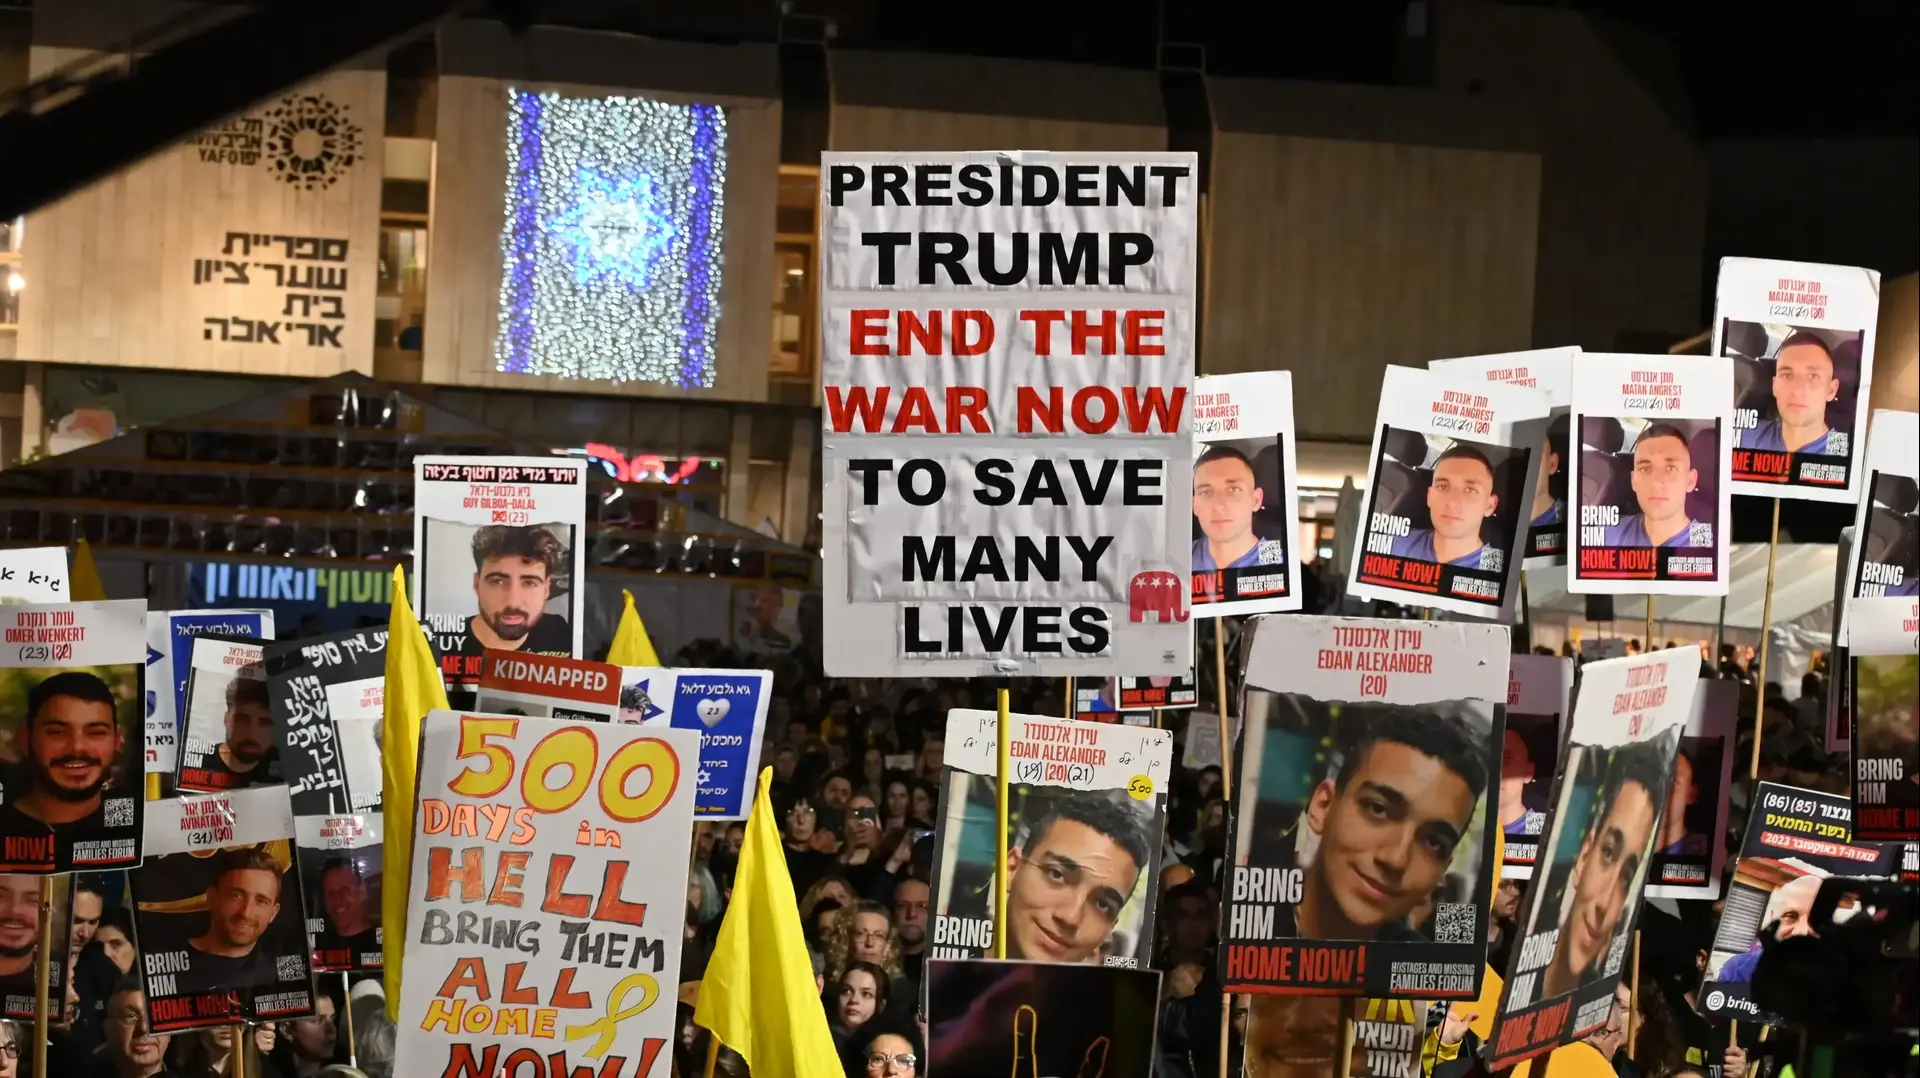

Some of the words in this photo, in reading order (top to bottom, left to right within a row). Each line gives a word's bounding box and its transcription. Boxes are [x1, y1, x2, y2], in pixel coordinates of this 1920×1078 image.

[829, 164, 1190, 207] PRESIDENT
[222, 231, 349, 262] ספריית
[861, 232, 1154, 286] TRUMP
[283, 293, 345, 319] בית
[1768, 291, 1794, 303] MATAN
[1796, 293, 1828, 307] ANGREST
[203, 316, 344, 348] אריאלה
[849, 309, 995, 356] END
[1020, 310, 1166, 356] THE
[1622, 384, 1647, 395] MATAN
[1649, 384, 1682, 397] ANGREST
[825, 386, 992, 433] WAR
[1017, 385, 1187, 434] NOW
[1206, 405, 1239, 418] ANGREST
[1432, 402, 1458, 416] MATAN
[1460, 407, 1495, 421] ANGREST
[424, 465, 460, 480] בעזה
[463, 465, 495, 482] חטוף
[523, 467, 546, 482] מדי
[1753, 453, 1790, 475] NOW!
[498, 467, 519, 484] זמן
[549, 467, 576, 483] יותר
[849, 458, 946, 506] TO
[973, 458, 1163, 506] SAVE
[1800, 468, 1825, 480] FAMILIES
[1826, 470, 1845, 482] FORUM
[463, 497, 479, 509] GUY
[480, 498, 536, 510] GILBOA-DALAL
[508, 512, 529, 525] (23)
[1371, 512, 1410, 537] BRING
[1581, 505, 1620, 526] BRING
[1367, 532, 1393, 555] HIM
[1581, 526, 1606, 546] HIM
[902, 536, 1114, 582] MANY
[1581, 549, 1617, 569] HOME
[1619, 548, 1657, 569] NOW!
[1668, 563, 1692, 573] FAMILIES
[1693, 563, 1713, 573] FORUM
[1364, 555, 1401, 578] HOME
[1402, 560, 1440, 585] NOW!
[1861, 561, 1904, 586] BRING
[1237, 580, 1263, 594] FAMILIES
[1264, 579, 1285, 591] FORUM
[1452, 582, 1478, 595] FAMILIES
[1478, 586, 1498, 598] FORUM
[1859, 581, 1885, 598] HIM
[50, 611, 74, 626] עומר
[5, 628, 34, 643] OMER
[38, 627, 86, 643] WENKERT
[904, 606, 1109, 653] LIVES
[1333, 626, 1389, 650] אלכסנדר
[1393, 629, 1422, 651] עידן
[19, 646, 49, 662] (23)
[1318, 649, 1352, 670] EDAN
[1356, 652, 1433, 674] ALEXANDER
[494, 659, 608, 692] KIDNAPPED
[1360, 675, 1387, 697] (20)
[736, 684, 751, 695] גיא
[706, 707, 719, 715] 23
[1612, 692, 1632, 715] EDAN
[1629, 686, 1667, 711] ALEXANDER
[1024, 723, 1070, 744] אלכסנדר
[1074, 729, 1098, 746] עידן
[185, 740, 216, 756] BRING
[1010, 741, 1039, 760] EDAN
[1042, 744, 1106, 766] ALEXANDER
[183, 753, 203, 768] HIM
[447, 715, 680, 823] 500
[1857, 758, 1904, 781] BRING
[182, 769, 208, 784] HOME
[290, 768, 342, 796] בבית
[1068, 765, 1095, 784] (21)
[1128, 779, 1152, 794] 500
[1857, 782, 1886, 804] HIM
[352, 791, 382, 809] BRING
[1763, 792, 1790, 812] (86)
[180, 814, 223, 831] AVINATAN
[422, 798, 536, 845] DAYS
[576, 820, 621, 848] in
[1766, 814, 1813, 833] החמאס
[1858, 808, 1900, 829] HOME
[187, 831, 212, 846] (31)
[1766, 833, 1790, 846] 2023
[1815, 822, 1846, 839] בשבי
[5, 834, 55, 861] NOW!
[73, 848, 107, 861] FAMILIES
[108, 847, 135, 859] FORUM
[424, 847, 647, 927] HELL
[1232, 867, 1304, 904] BRING
[933, 915, 994, 949] BRING
[1229, 904, 1275, 940] HIM
[420, 908, 541, 956] BRING
[559, 920, 664, 972] THEM
[1516, 928, 1560, 973] BRING
[145, 950, 190, 976] BRING
[1226, 945, 1292, 981] HOME
[1299, 945, 1366, 984] NOW!
[1391, 962, 1427, 974] HOSTAGES
[1428, 963, 1442, 974] AND
[1443, 963, 1475, 976] MISSING
[148, 974, 177, 998] HIM
[436, 957, 592, 1008] ALL
[1390, 975, 1436, 991] FAMILIES
[1438, 976, 1475, 992] FORUM
[1505, 972, 1537, 1014] HIM
[152, 996, 192, 1022] HOME
[255, 1000, 285, 1014] FAMILIES
[286, 998, 310, 1011] FORUM
[420, 998, 557, 1039] HOME
[1496, 1012, 1537, 1057] HOME
[1532, 995, 1572, 1044] NOW!
[441, 1038, 667, 1078] NOW!
